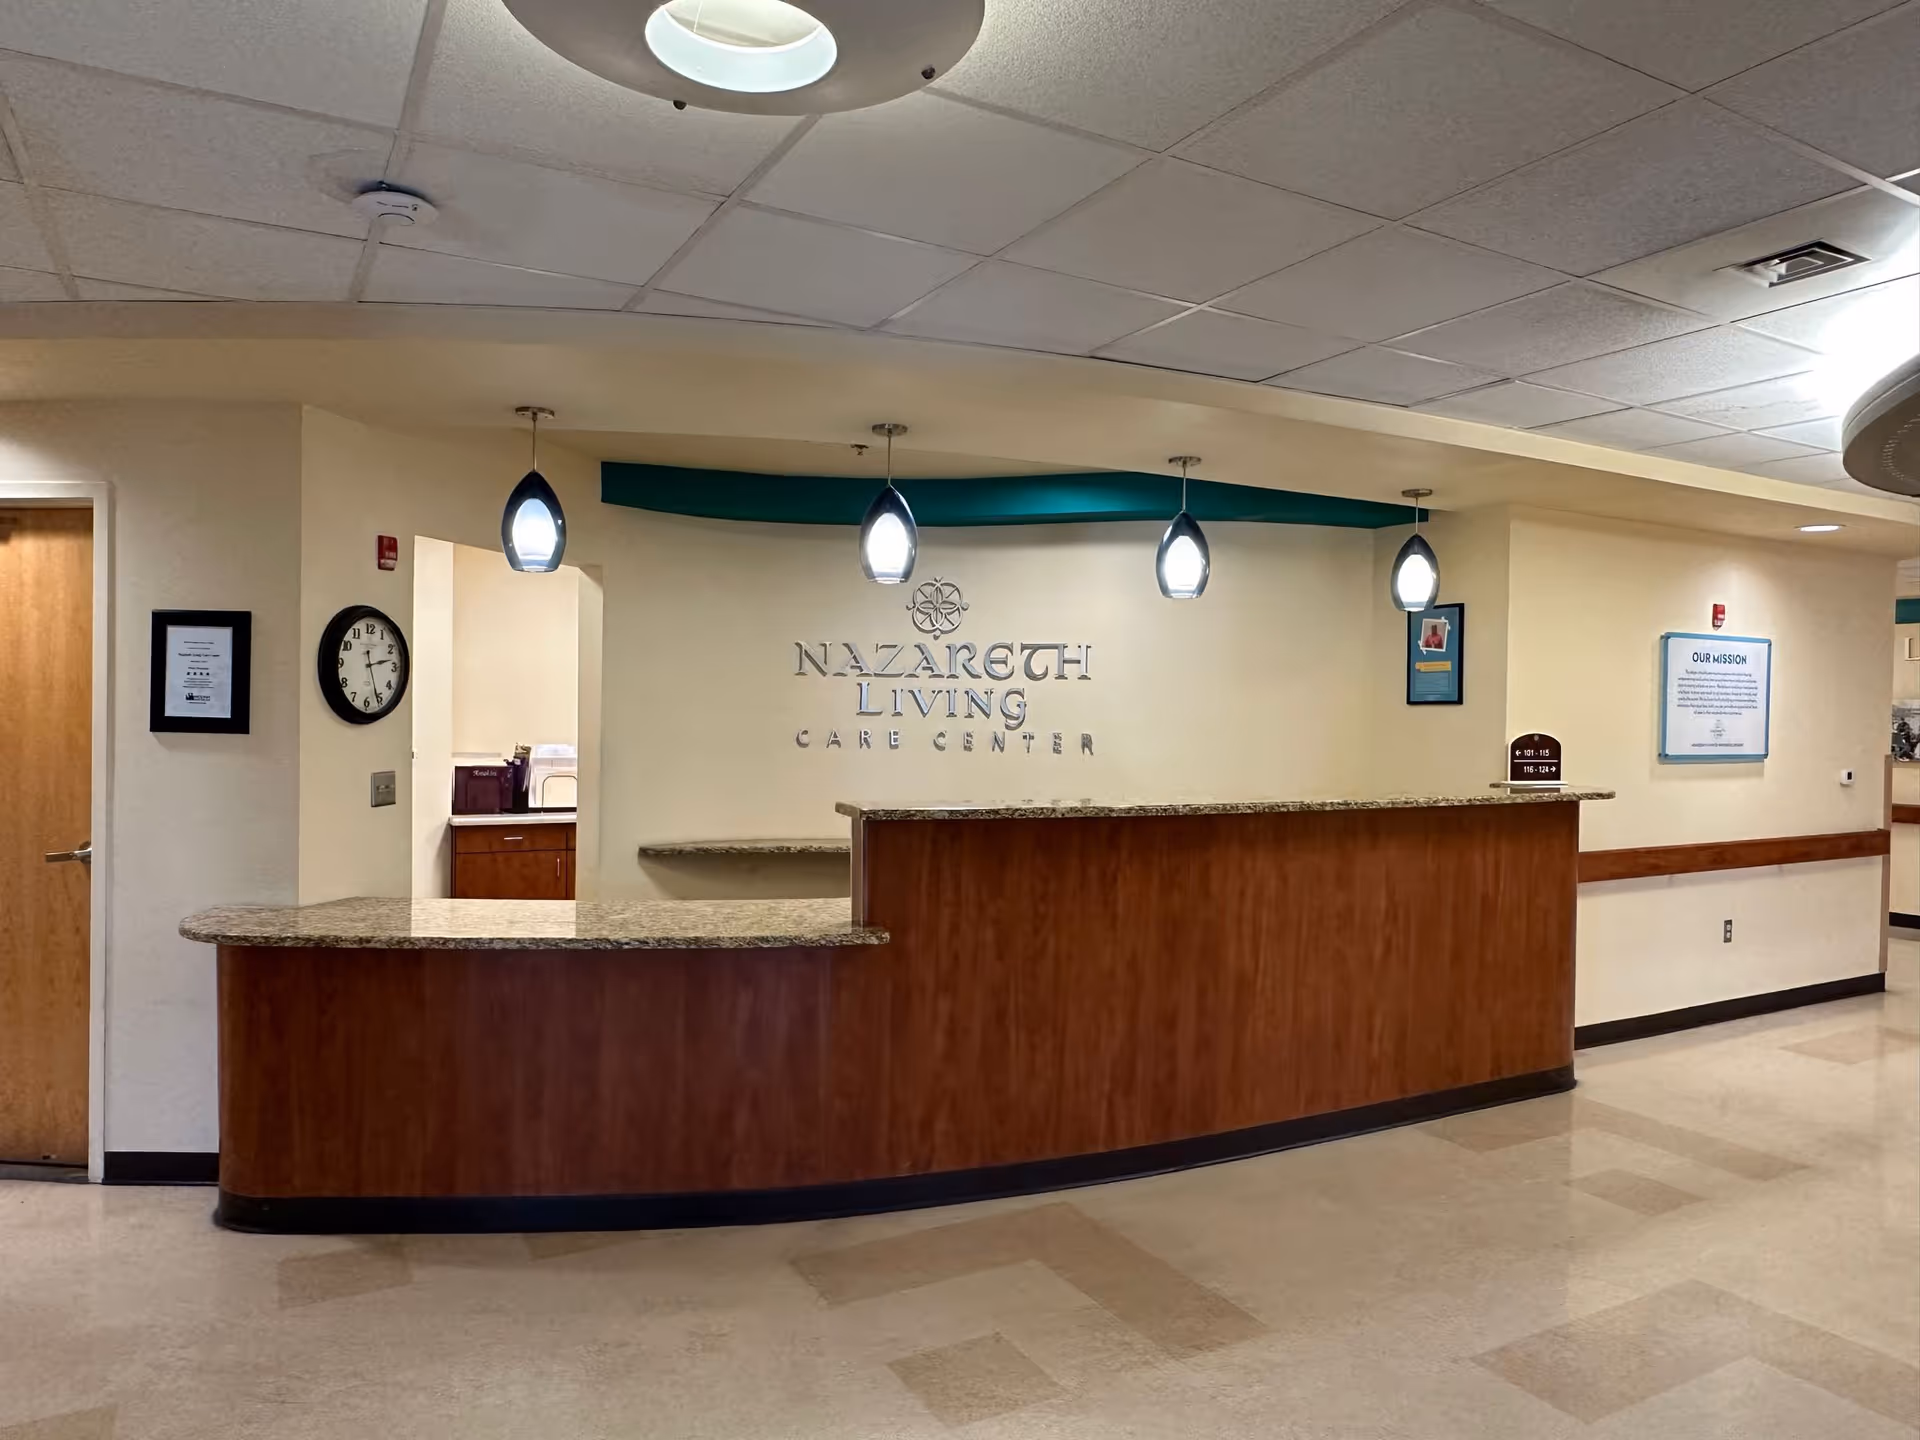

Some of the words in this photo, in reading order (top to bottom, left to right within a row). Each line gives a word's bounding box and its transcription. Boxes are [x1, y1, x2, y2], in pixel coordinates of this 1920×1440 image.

[352, 627, 361, 640] 11
[365, 623, 376, 635] 12
[342, 640, 352, 652] 10
[387, 643, 394, 655] 2
[794, 641, 1094, 681] NAZARETH
[1692, 652, 1711, 664] OUR
[1712, 653, 1747, 665] MISSION
[391, 662, 398, 673] 3
[341, 677, 348, 688] 8
[385, 680, 392, 690] 4
[350, 691, 357, 703] 7
[363, 696, 370, 709] 6
[856, 681, 1027, 730] LIVING
[795, 729, 901, 750] CARE
[933, 730, 1094, 756] CENTER
